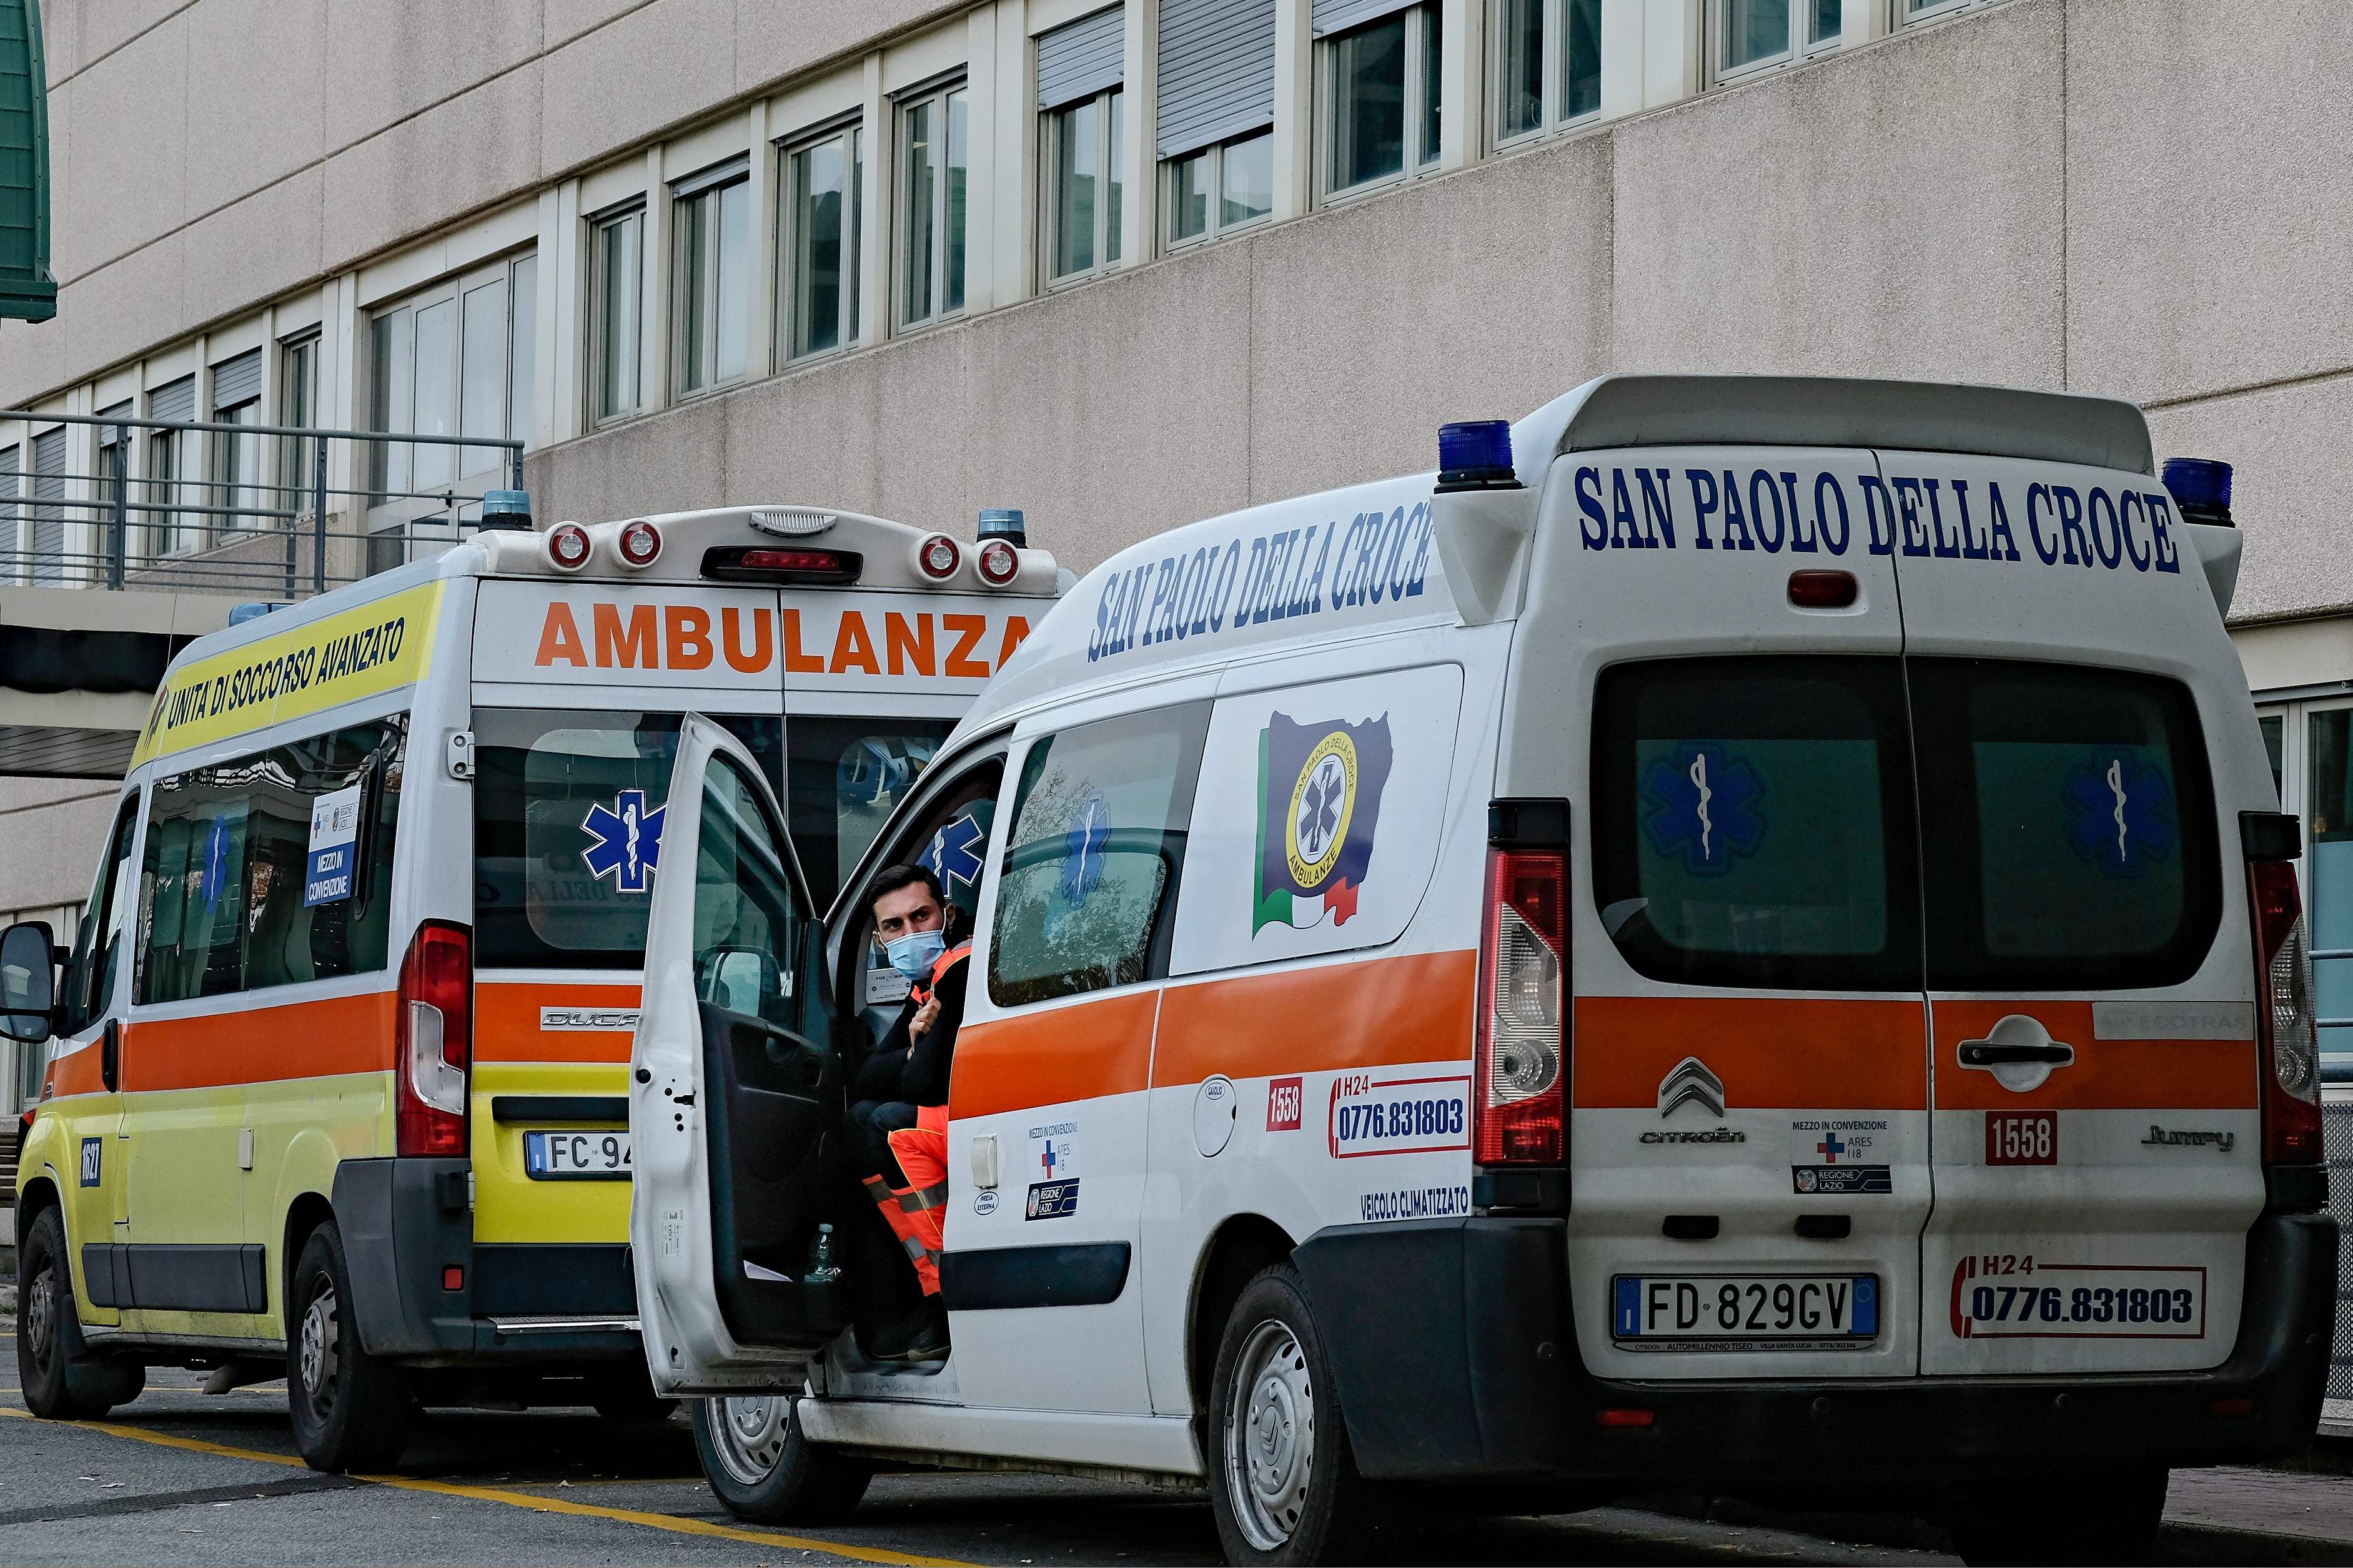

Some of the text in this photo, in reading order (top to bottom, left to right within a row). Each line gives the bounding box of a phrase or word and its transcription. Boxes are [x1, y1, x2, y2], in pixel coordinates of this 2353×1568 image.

[1574, 466, 2181, 574] SAN PAOLO DELLA CROCE
[1088, 501, 1435, 663] SAN PAOLO DELLA CROCE
[210, 674, 230, 716] DI
[228, 646, 315, 711] SOCCORSO
[314, 616, 405, 686] AVANZATO
[1295, 737, 1354, 800] SAN PAOLO DELLA CROCE
[317, 850, 344, 874] MEZZO IN
[1289, 847, 1337, 884] AMBULANZE
[309, 875, 347, 901] CONVENZIONE
[1344, 1075, 1369, 1097] H24
[1271, 1086, 1299, 1122] 1558
[1029, 1122, 1078, 1139] MEZZO IN CONVENZIONE
[1339, 1098, 1463, 1141] 0776.831803
[1793, 1121, 1888, 1130] MEZZO IN CONVENZIONE
[551, 1137, 588, 1168] FC
[1057, 1143, 1070, 1155] ARES
[1848, 1137, 1872, 1147] ARES
[1993, 1118, 2051, 1158] 1558
[2141, 1125, 2234, 1152] Jumpy
[82, 1143, 100, 1180] 1627
[1057, 1159, 1065, 1171] 118
[1848, 1149, 1861, 1158] 118
[1039, 1203, 1053, 1213] LAZIO
[1040, 1188, 1060, 1200] REGIONE
[1361, 1186, 1469, 1221] VEICOLO CLIMATIZZATO
[1983, 1255, 2034, 1275] H24
[1648, 1283, 1698, 1329] FD
[1718, 1283, 1847, 1329] 829GV
[1972, 1286, 2192, 1323] 0776.831803
